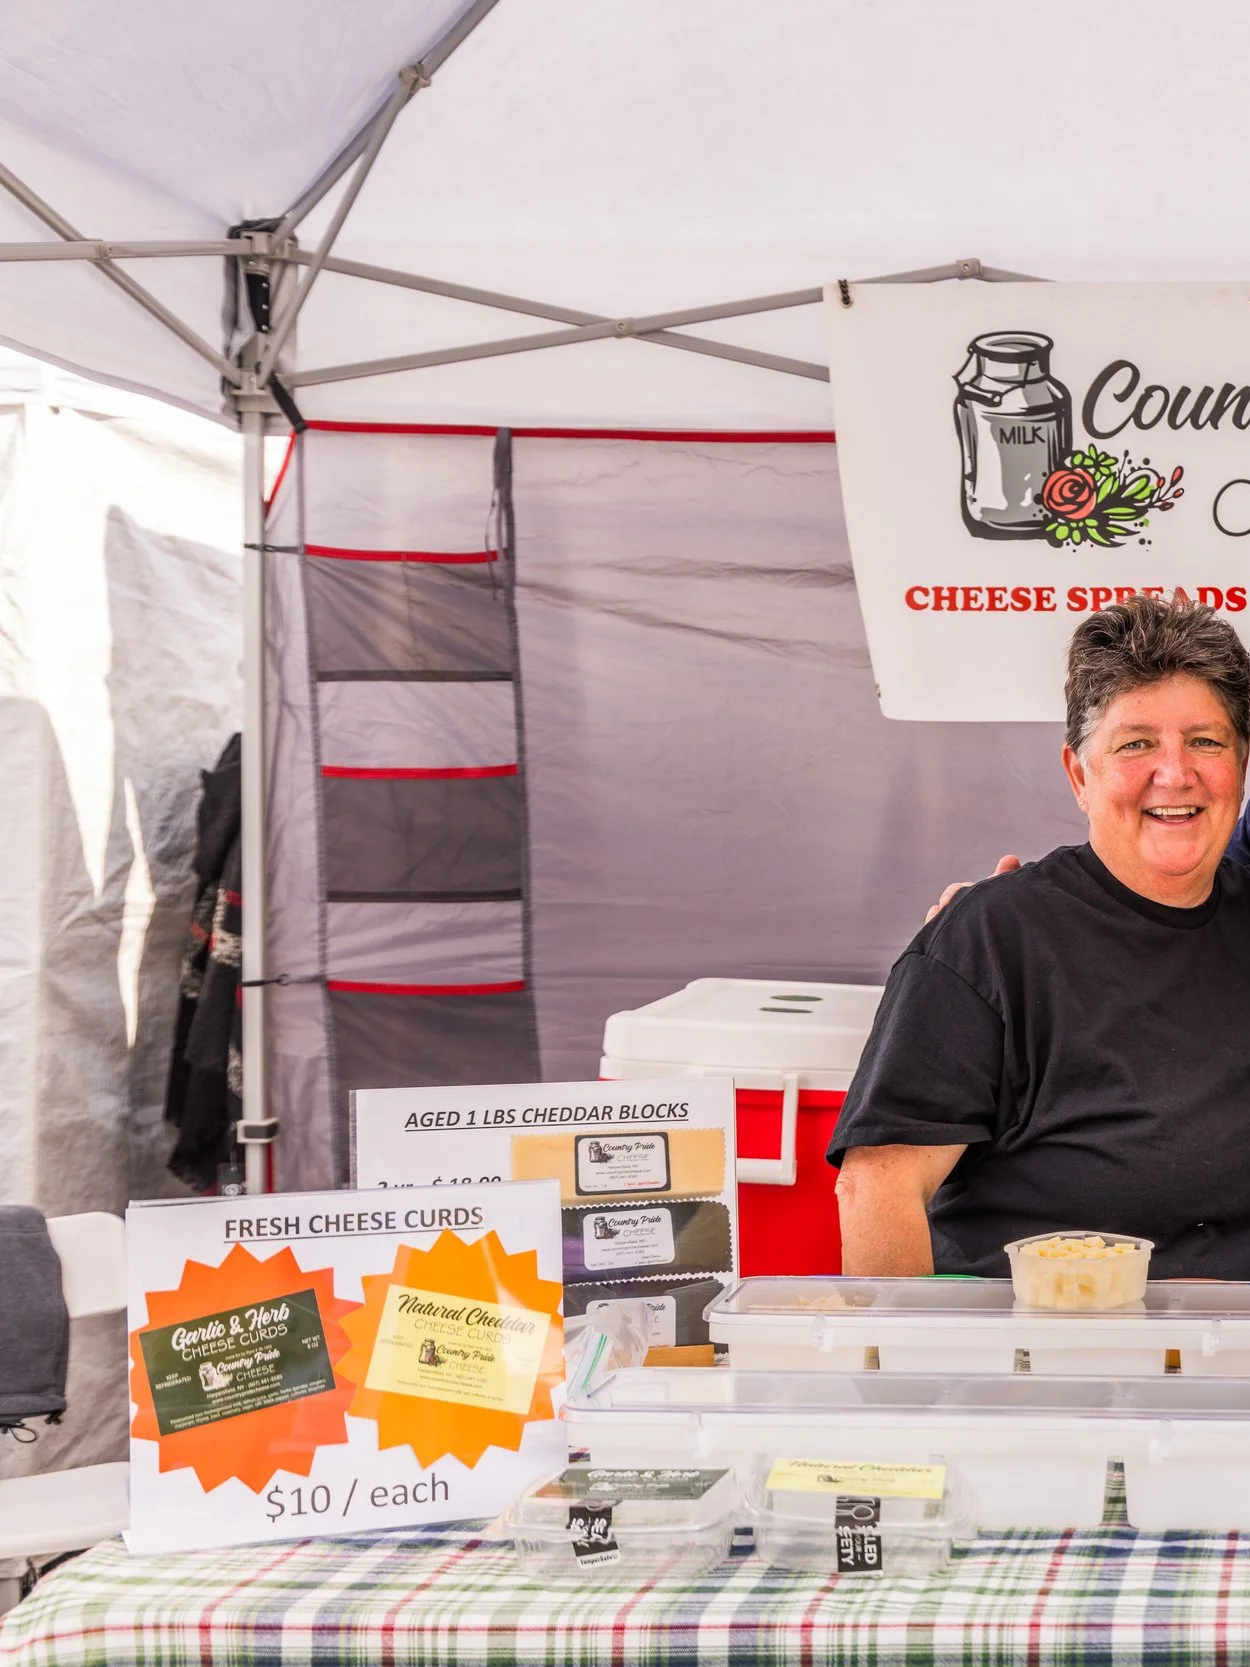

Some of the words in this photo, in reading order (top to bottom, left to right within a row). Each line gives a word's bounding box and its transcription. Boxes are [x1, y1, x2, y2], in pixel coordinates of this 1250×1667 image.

[1000, 426, 1045, 446] MILK
[904, 585, 1057, 613] CHEESE
[404, 1110, 461, 1129] AGED
[465, 1109, 477, 1126] 1
[483, 1108, 516, 1125] LBS
[521, 1105, 613, 1124] CHEDDAR
[618, 1102, 690, 1121] BLOCKS
[224, 1216, 301, 1240] FRESH
[307, 1211, 397, 1235] CHEESE
[403, 1206, 485, 1230] CURDS
[172, 1319, 227, 1351] Garlic
[229, 1315, 245, 1334] &
[245, 1303, 290, 1331] Herb
[398, 1293, 466, 1321] Natural
[465, 1307, 536, 1334] Cheddar
[181, 1337, 236, 1362] CHEESE
[239, 1323, 288, 1346] CURDS
[414, 1319, 465, 1337] CHEESE
[467, 1328, 511, 1345] CURDS
[436, 1345, 470, 1361] Country
[236, 1364, 275, 1382] CHEESE
[265, 1485, 331, 1522] $10
[370, 1472, 450, 1508] each
